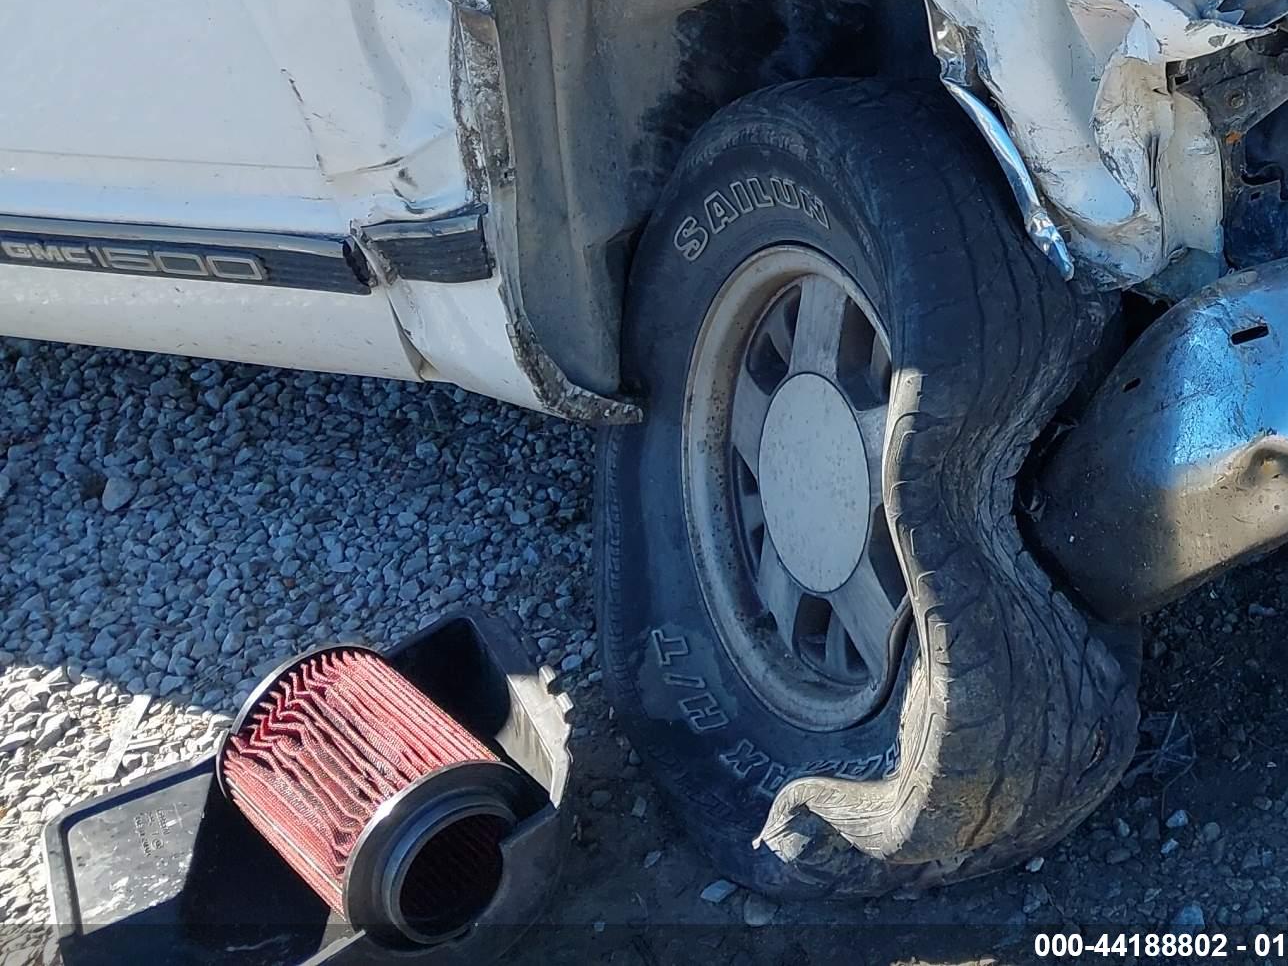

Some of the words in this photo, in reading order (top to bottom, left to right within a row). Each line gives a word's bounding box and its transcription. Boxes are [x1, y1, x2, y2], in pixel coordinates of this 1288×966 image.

[673, 176, 831, 262] SAILUN
[1, 241, 93, 265] GMC
[89, 242, 263, 281] 1500
